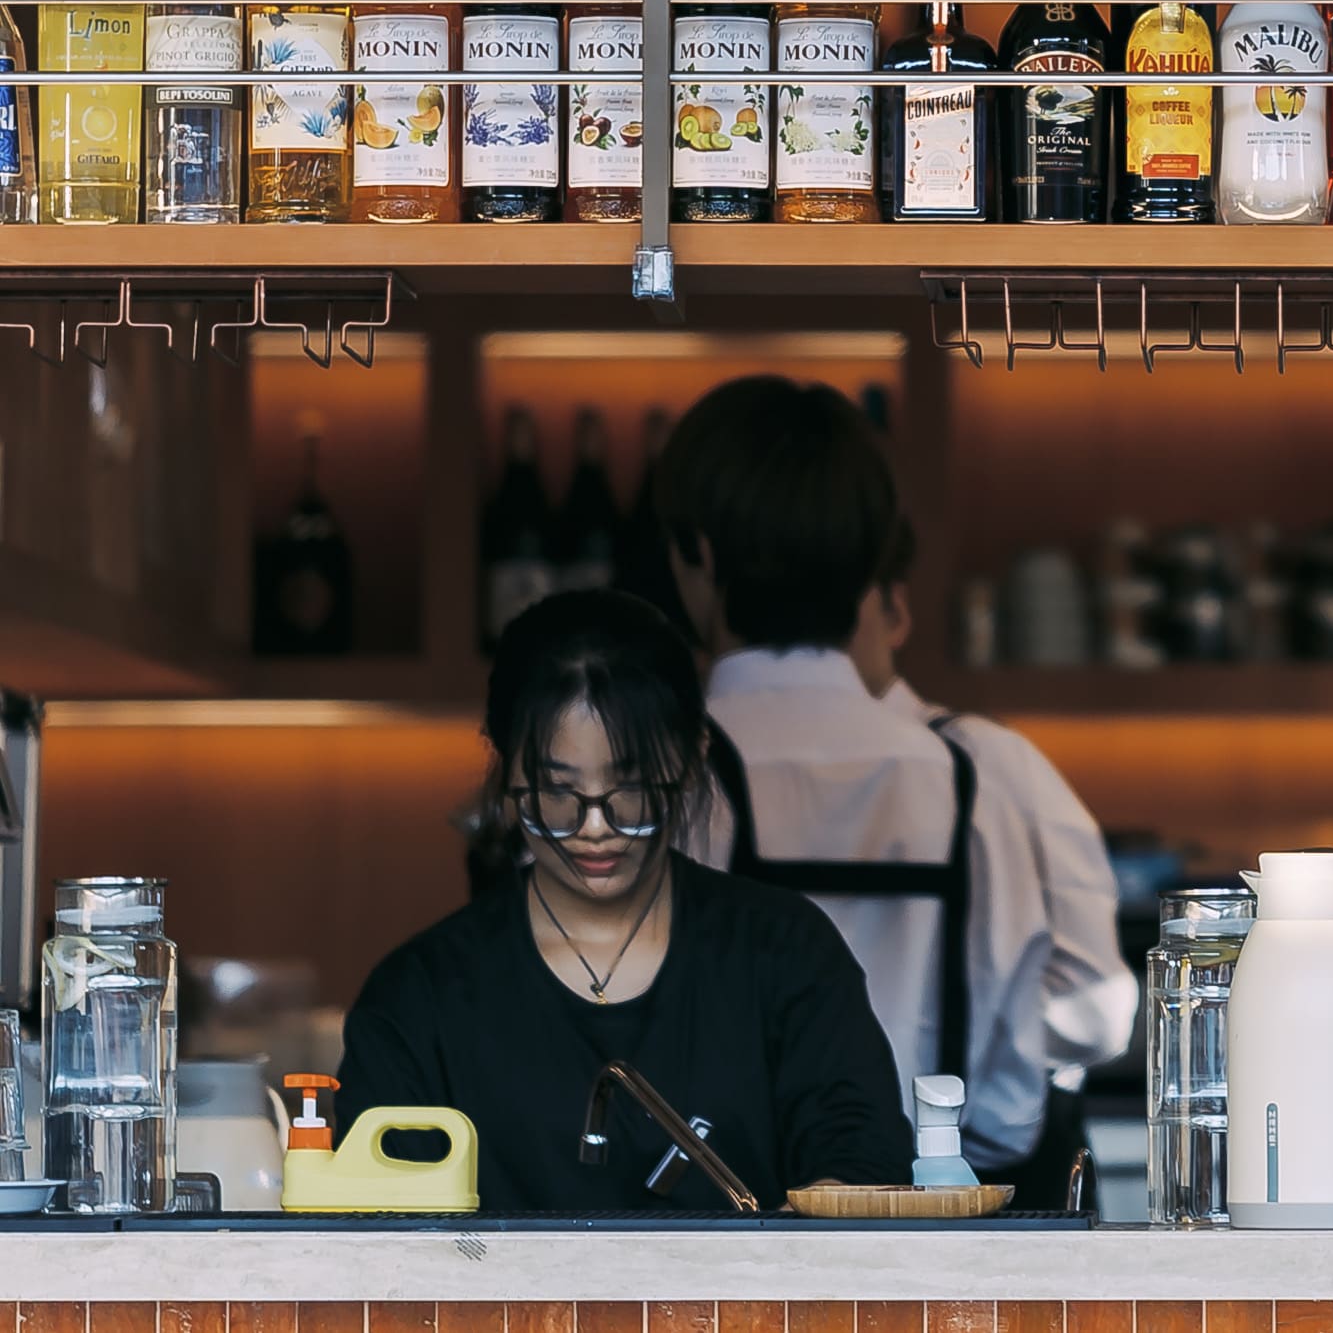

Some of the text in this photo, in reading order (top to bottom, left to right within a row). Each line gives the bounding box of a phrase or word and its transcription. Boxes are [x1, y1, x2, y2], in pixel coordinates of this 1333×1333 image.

[358, 40, 438, 58] MONIN
[1234, 24, 1324, 64] MALIBU
[469, 42, 550, 59] MONIN
[680, 42, 761, 60] MONIN
[784, 44, 866, 61] MONIN
[156, 51, 235, 63] PINOT GRIGIO
[160, 90, 231, 101] BEPI TOSOLINI
[906, 89, 972, 120] COINTREAU
[1152, 101, 1191, 112] COFFEE
[1149, 113, 1194, 125] LIQUEUR
[1050, 127, 1071, 136] The
[1028, 135, 1092, 146] ORIGINAL
[77, 155, 120, 165] GIFFARD
